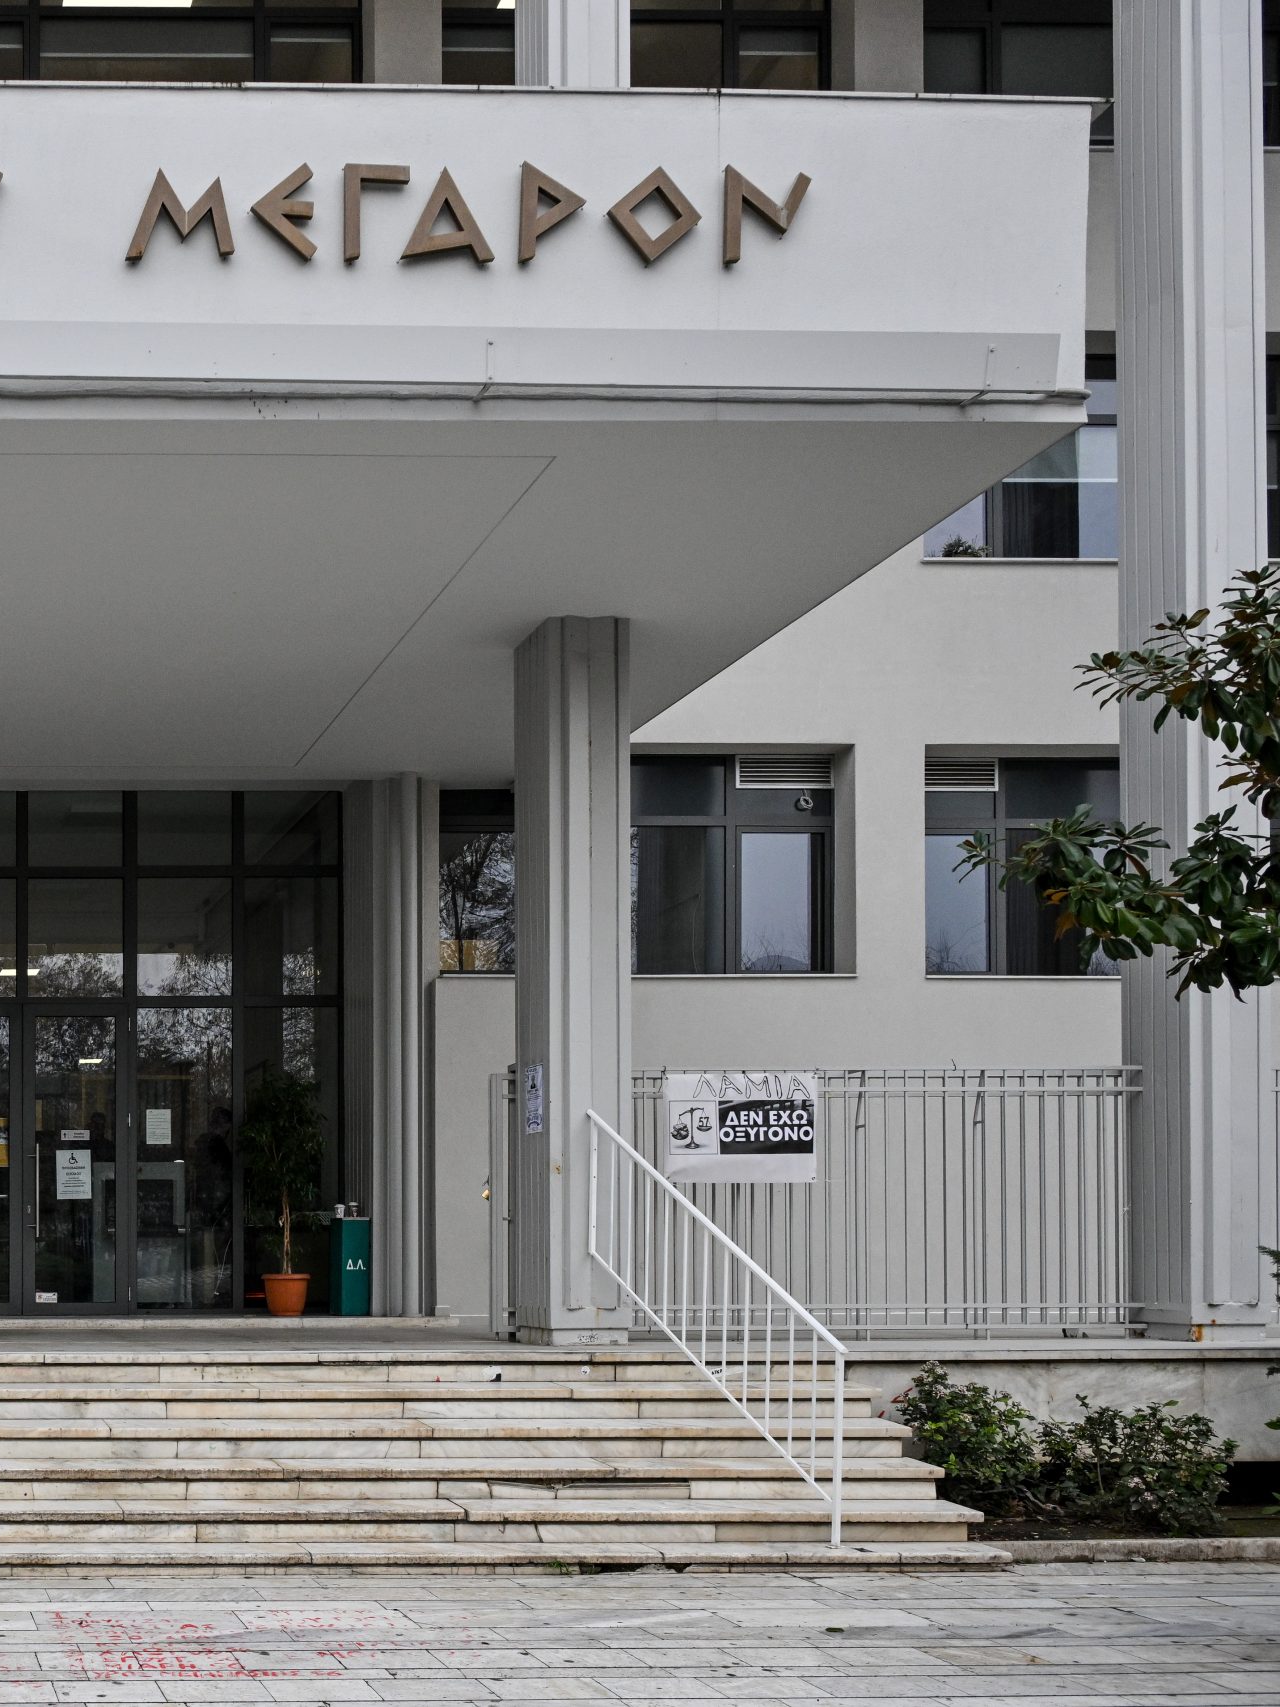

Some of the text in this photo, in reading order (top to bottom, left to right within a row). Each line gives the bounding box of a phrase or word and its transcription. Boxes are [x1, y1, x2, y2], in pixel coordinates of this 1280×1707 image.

[124, 161, 812, 267] ΜΕΓΑΡΟΝ
[692, 1074, 810, 1099] ΛΑΜΙΑ
[698, 1116, 710, 1127] 57
[725, 1110, 808, 1126] ΔΕΝ ΕΧΩ
[720, 1126, 813, 1142] ΟΞΥΓΟΝΟ
[346, 1258, 366, 1270] Δ.Λ.
